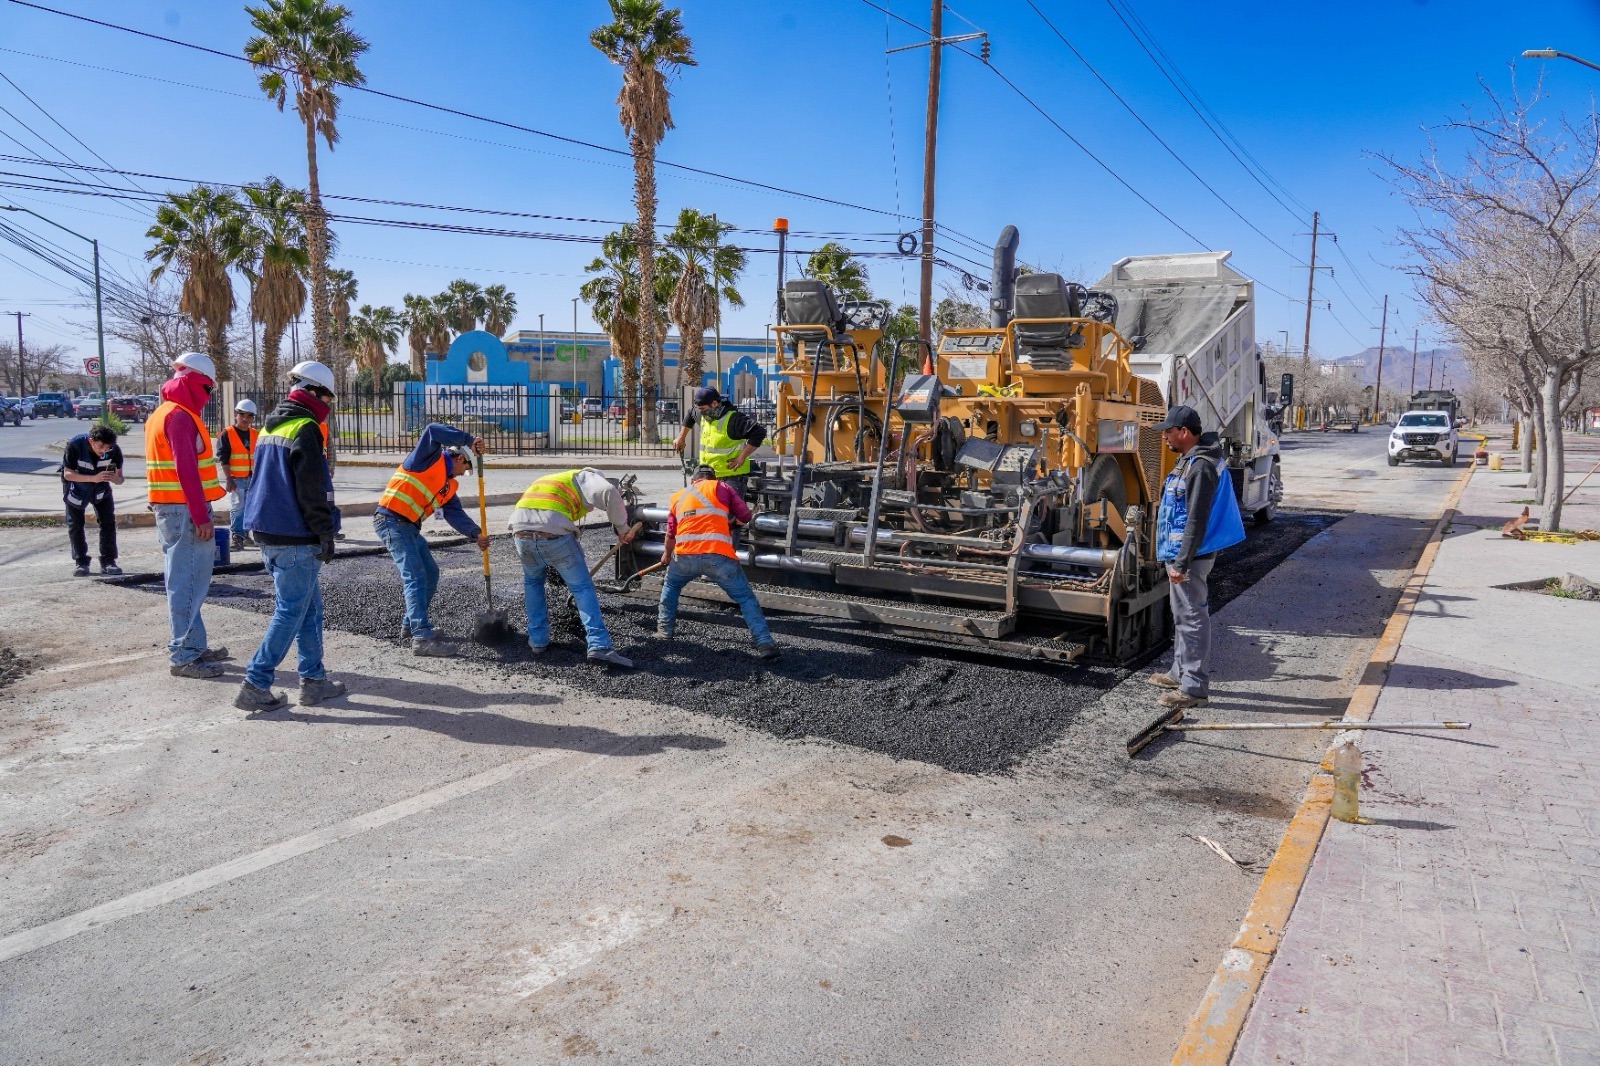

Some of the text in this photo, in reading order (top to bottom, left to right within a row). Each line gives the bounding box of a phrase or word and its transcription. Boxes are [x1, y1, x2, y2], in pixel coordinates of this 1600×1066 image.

[557, 344, 586, 362] CTI
[90, 362, 100, 370] 50
[438, 387, 514, 404] Amphenol
[1123, 425, 1135, 451] CAT
